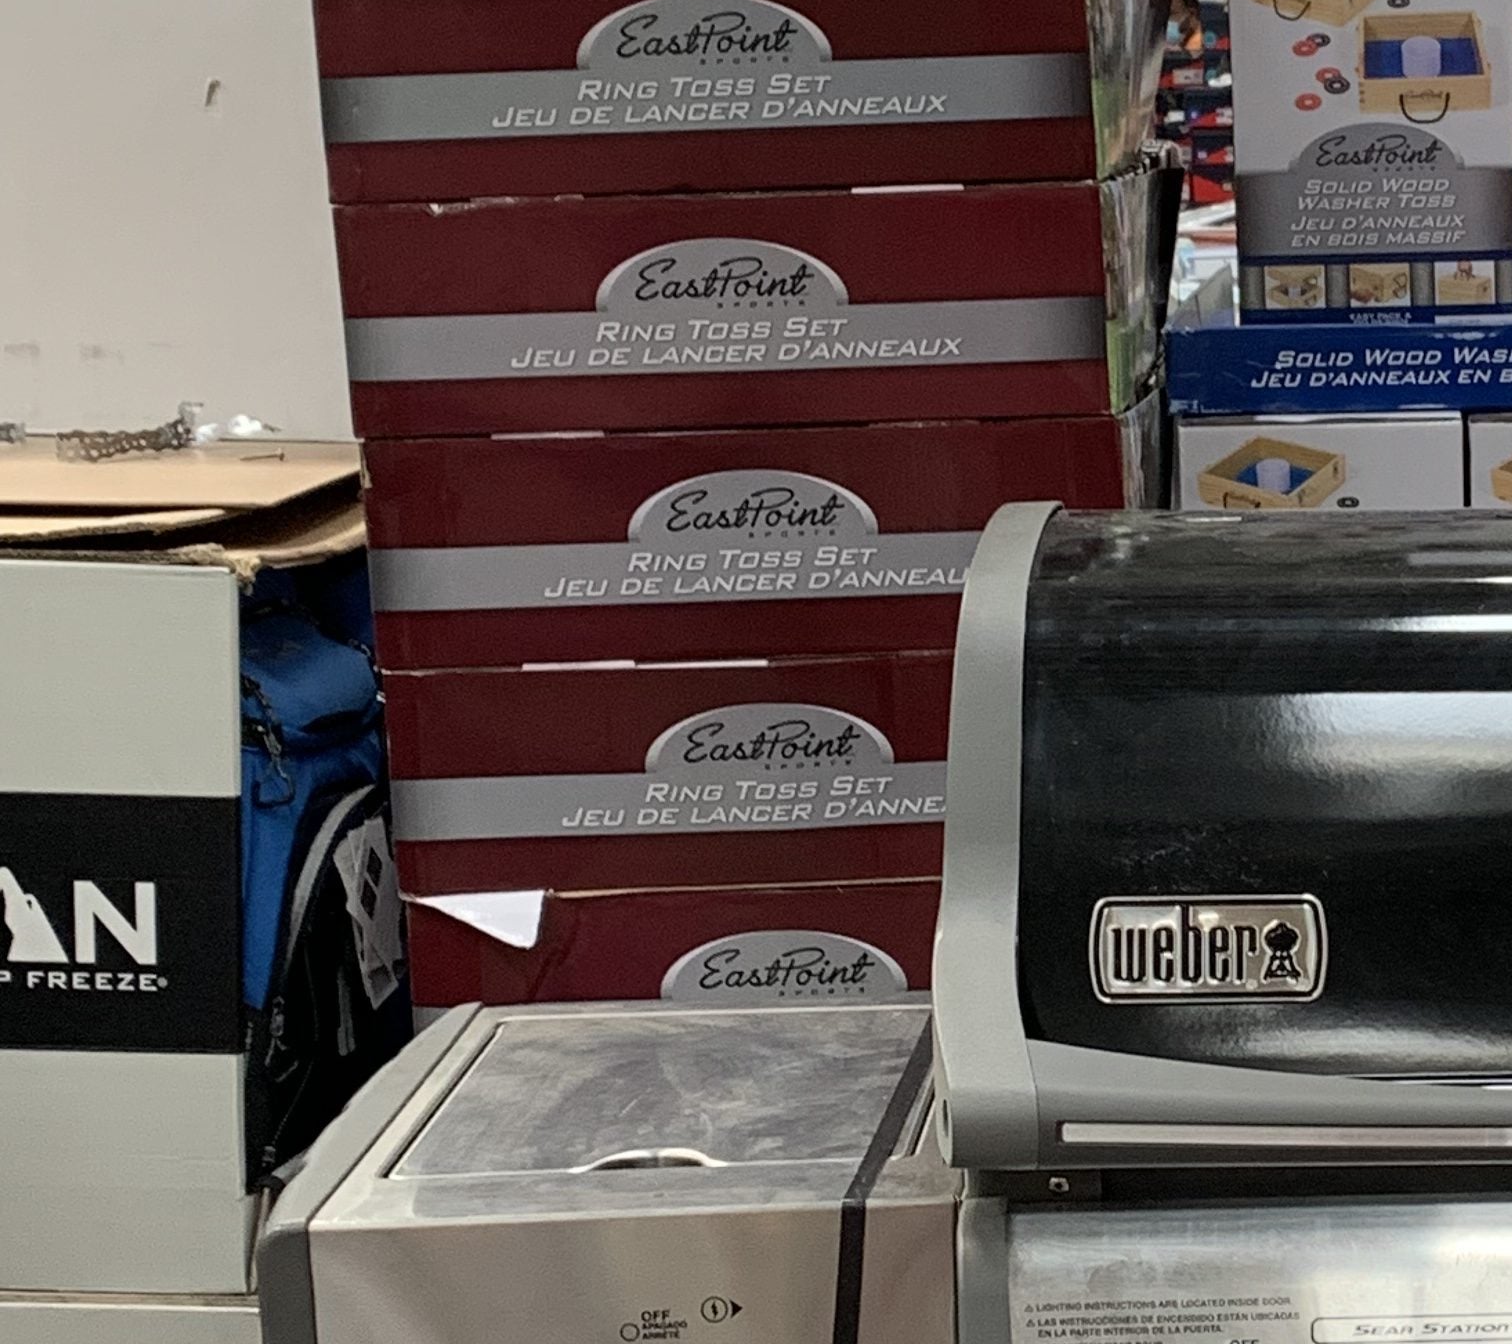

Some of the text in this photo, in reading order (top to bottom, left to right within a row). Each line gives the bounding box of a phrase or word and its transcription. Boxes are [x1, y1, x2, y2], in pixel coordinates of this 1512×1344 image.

[616, 11, 798, 58] EastPoint
[577, 73, 832, 101] RING TOSS SET
[492, 94, 947, 128] JEU DE LANCER D'ANNEAUX
[1316, 134, 1443, 167] EastPoint
[1304, 178, 1450, 194] SOLID WOOD
[1297, 194, 1457, 211] WASHER TOSS
[1290, 214, 1466, 231] JEU D'ANNEAUX
[1291, 230, 1467, 247] EN BOIS MASSIF
[635, 257, 814, 302] EastPoint
[596, 316, 848, 343] RING TOSS SET
[511, 337, 962, 369] JEU DE LANCER D'ANNEAUX
[1274, 350, 1354, 369] SOLID
[1364, 348, 1442, 367] WOOD
[1251, 371, 1302, 389] JEU
[1309, 368, 1451, 387] D'ANNEAUX
[1457, 368, 1492, 384] EN
[666, 487, 844, 532] EastPoint
[627, 546, 878, 573] RING TOSS SET
[544, 566, 970, 598] JEU DE LANCER D'ANNEAU
[684, 719, 862, 763] EastPoint
[645, 776, 893, 803] RING TOSS SET
[561, 803, 812, 828] JEU DE LANCER
[1110, 906, 1258, 983] weber
[27, 970, 158, 992] FREEZE
[700, 946, 874, 991] EastPoint
[641, 1309, 670, 1322] OFF
[1353, 1322, 1510, 1336] SEAR STATION
